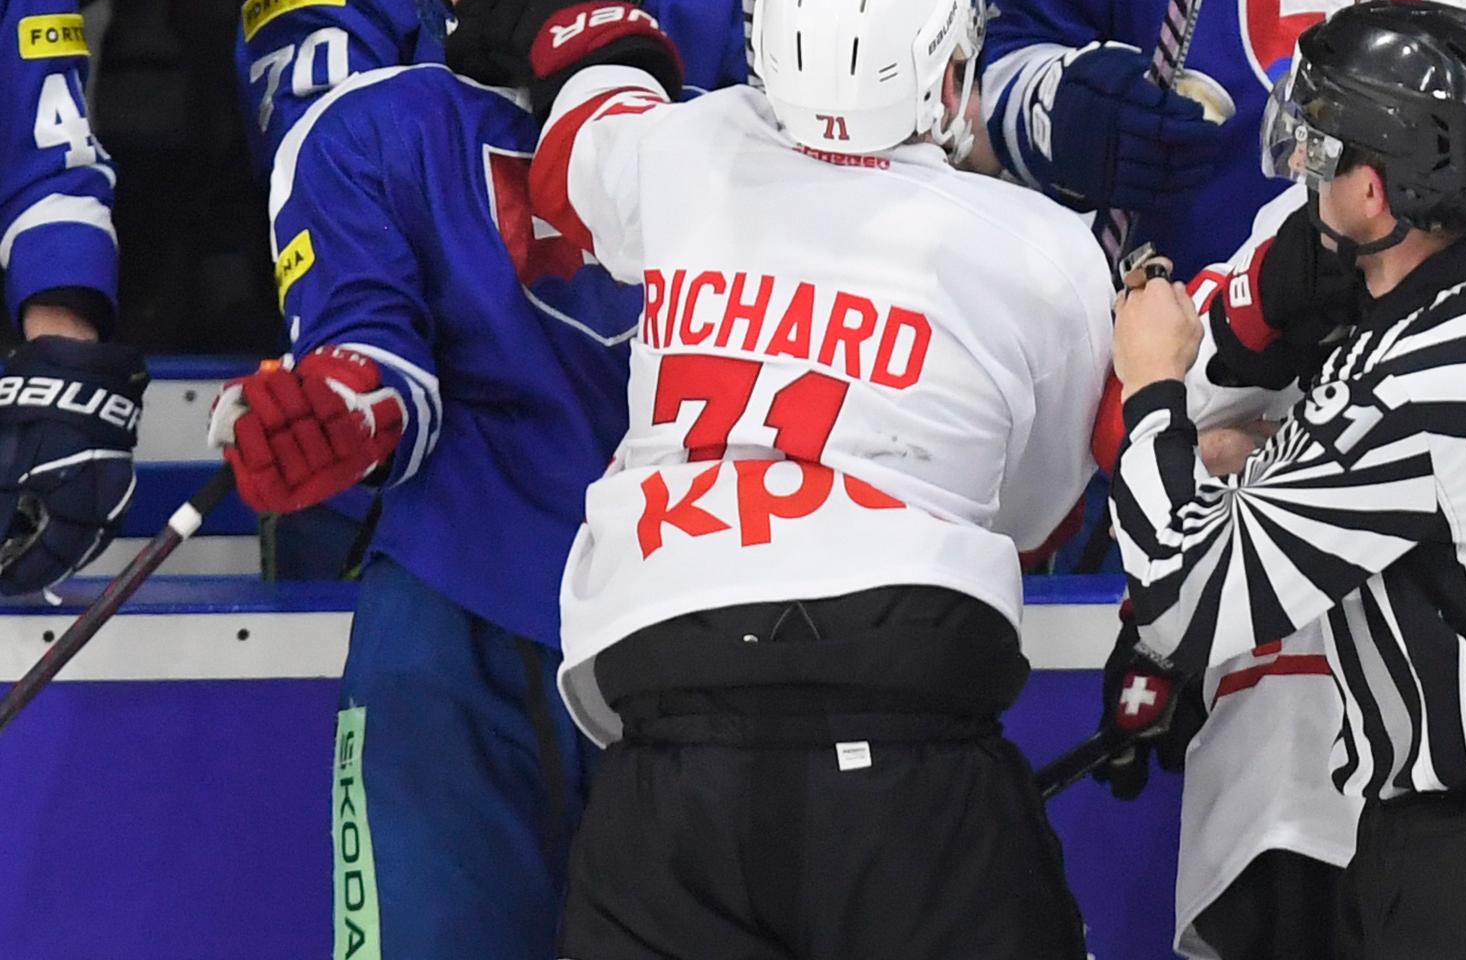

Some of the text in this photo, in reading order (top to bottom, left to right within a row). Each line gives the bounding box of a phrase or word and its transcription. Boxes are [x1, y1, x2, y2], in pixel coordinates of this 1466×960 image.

[249, 26, 349, 133] 70
[815, 113, 851, 141] 71
[643, 268, 932, 391] RICHARD
[651, 352, 851, 465] 71
[1304, 380, 1385, 455] 91
